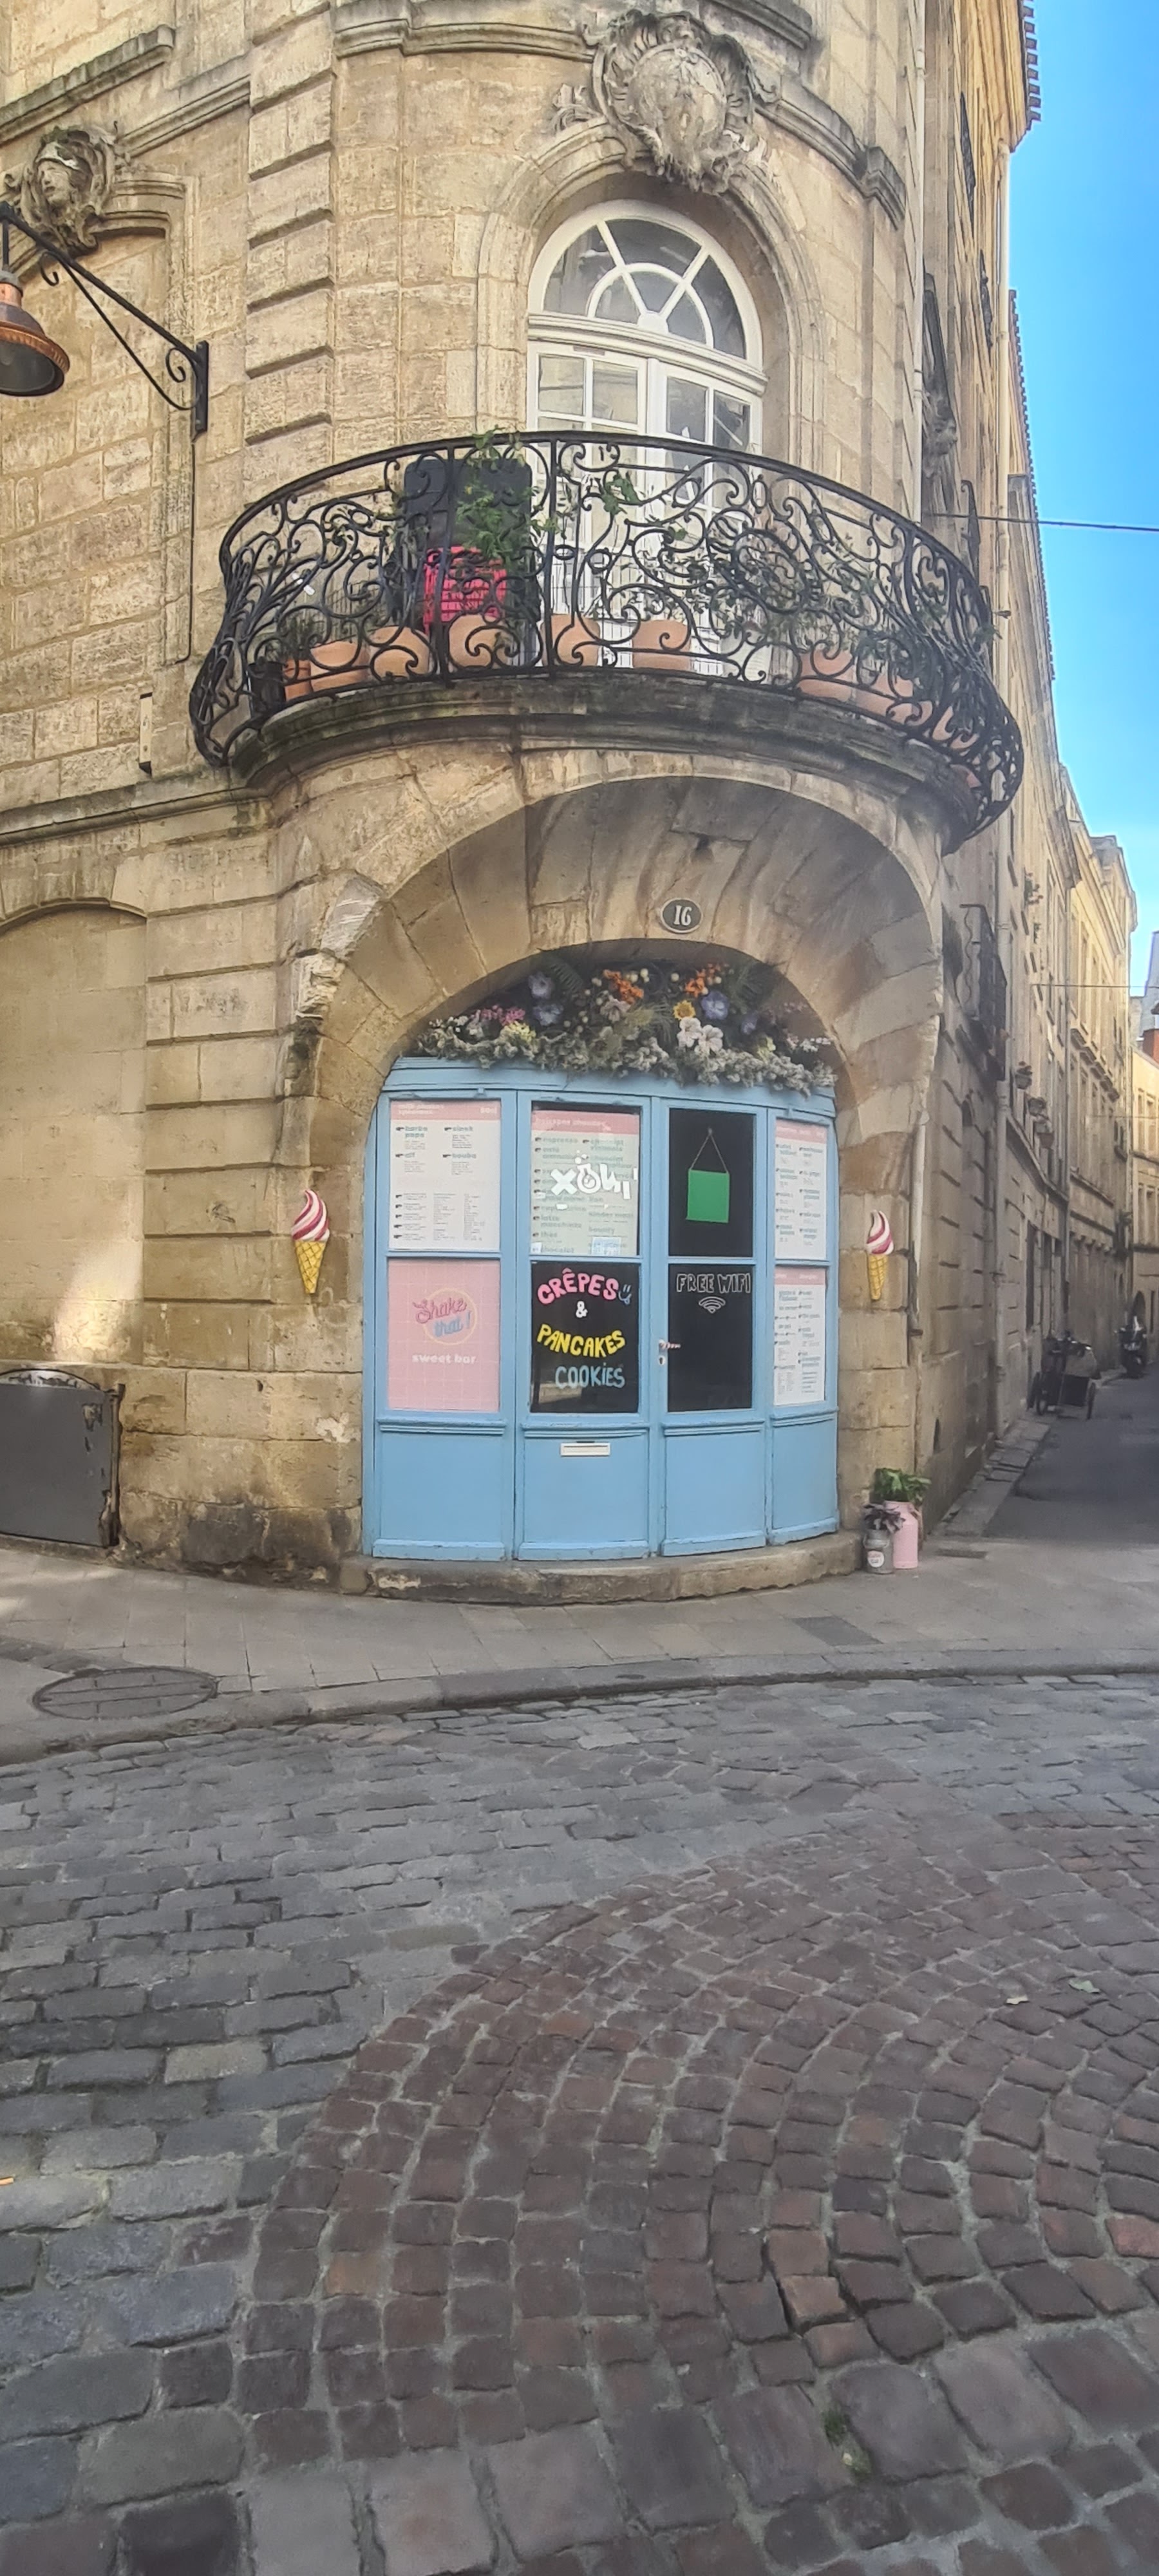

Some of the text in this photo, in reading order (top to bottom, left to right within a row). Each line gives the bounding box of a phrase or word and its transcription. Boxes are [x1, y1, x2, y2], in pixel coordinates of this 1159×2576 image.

[674, 905, 692, 926] 16
[537, 1267, 619, 1304] CRÊPES
[676, 1273, 751, 1294] FREE WIFI
[412, 1296, 467, 1324] Shake
[575, 1300, 588, 1318] &
[536, 1323, 626, 1358] PANCAKES
[412, 1353, 476, 1365] sweet bar
